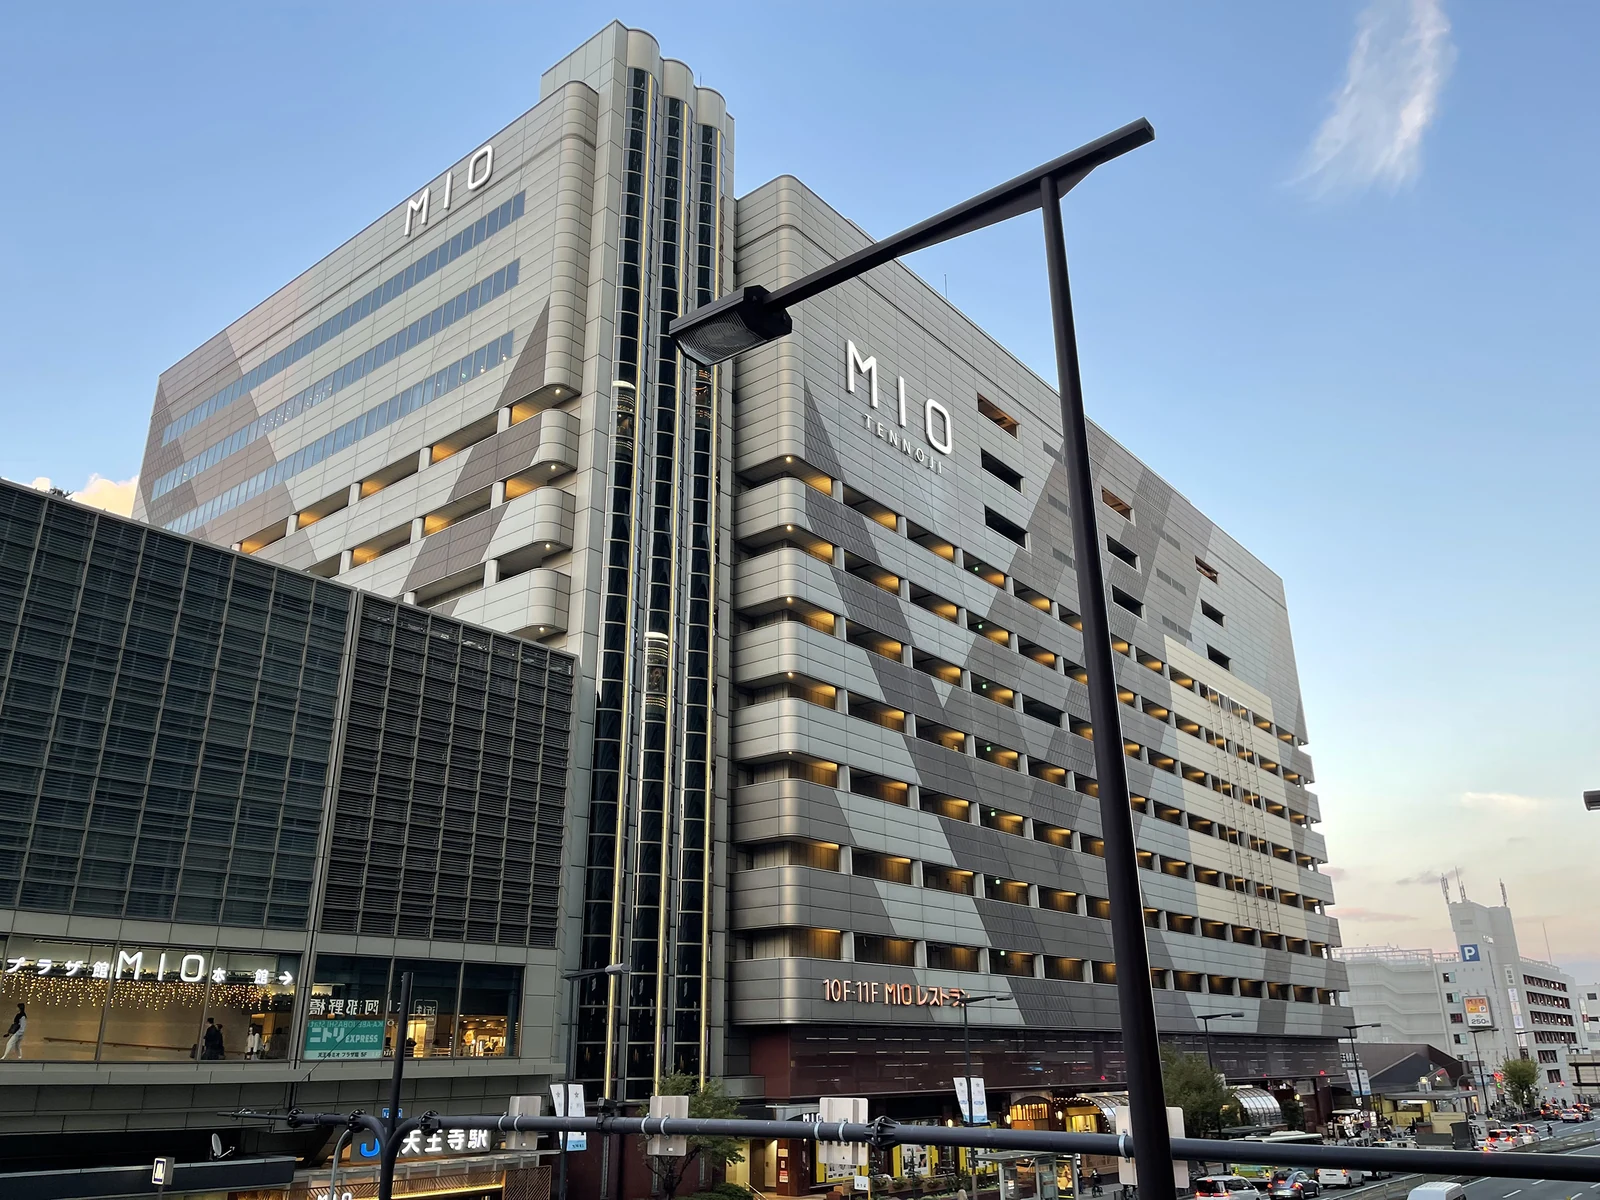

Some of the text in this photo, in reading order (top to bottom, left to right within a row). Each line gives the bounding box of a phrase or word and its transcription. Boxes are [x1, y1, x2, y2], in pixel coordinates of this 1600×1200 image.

[404, 144, 493, 237] MIO
[845, 339, 952, 455] MIO
[863, 413, 942, 474] TENNOJI
[5, 956, 110, 979] プラザ館
[115, 950, 205, 983] MIO
[883, 983, 912, 1006] MIO
[310, 1027, 378, 1043] ニトリ EXPRESS
